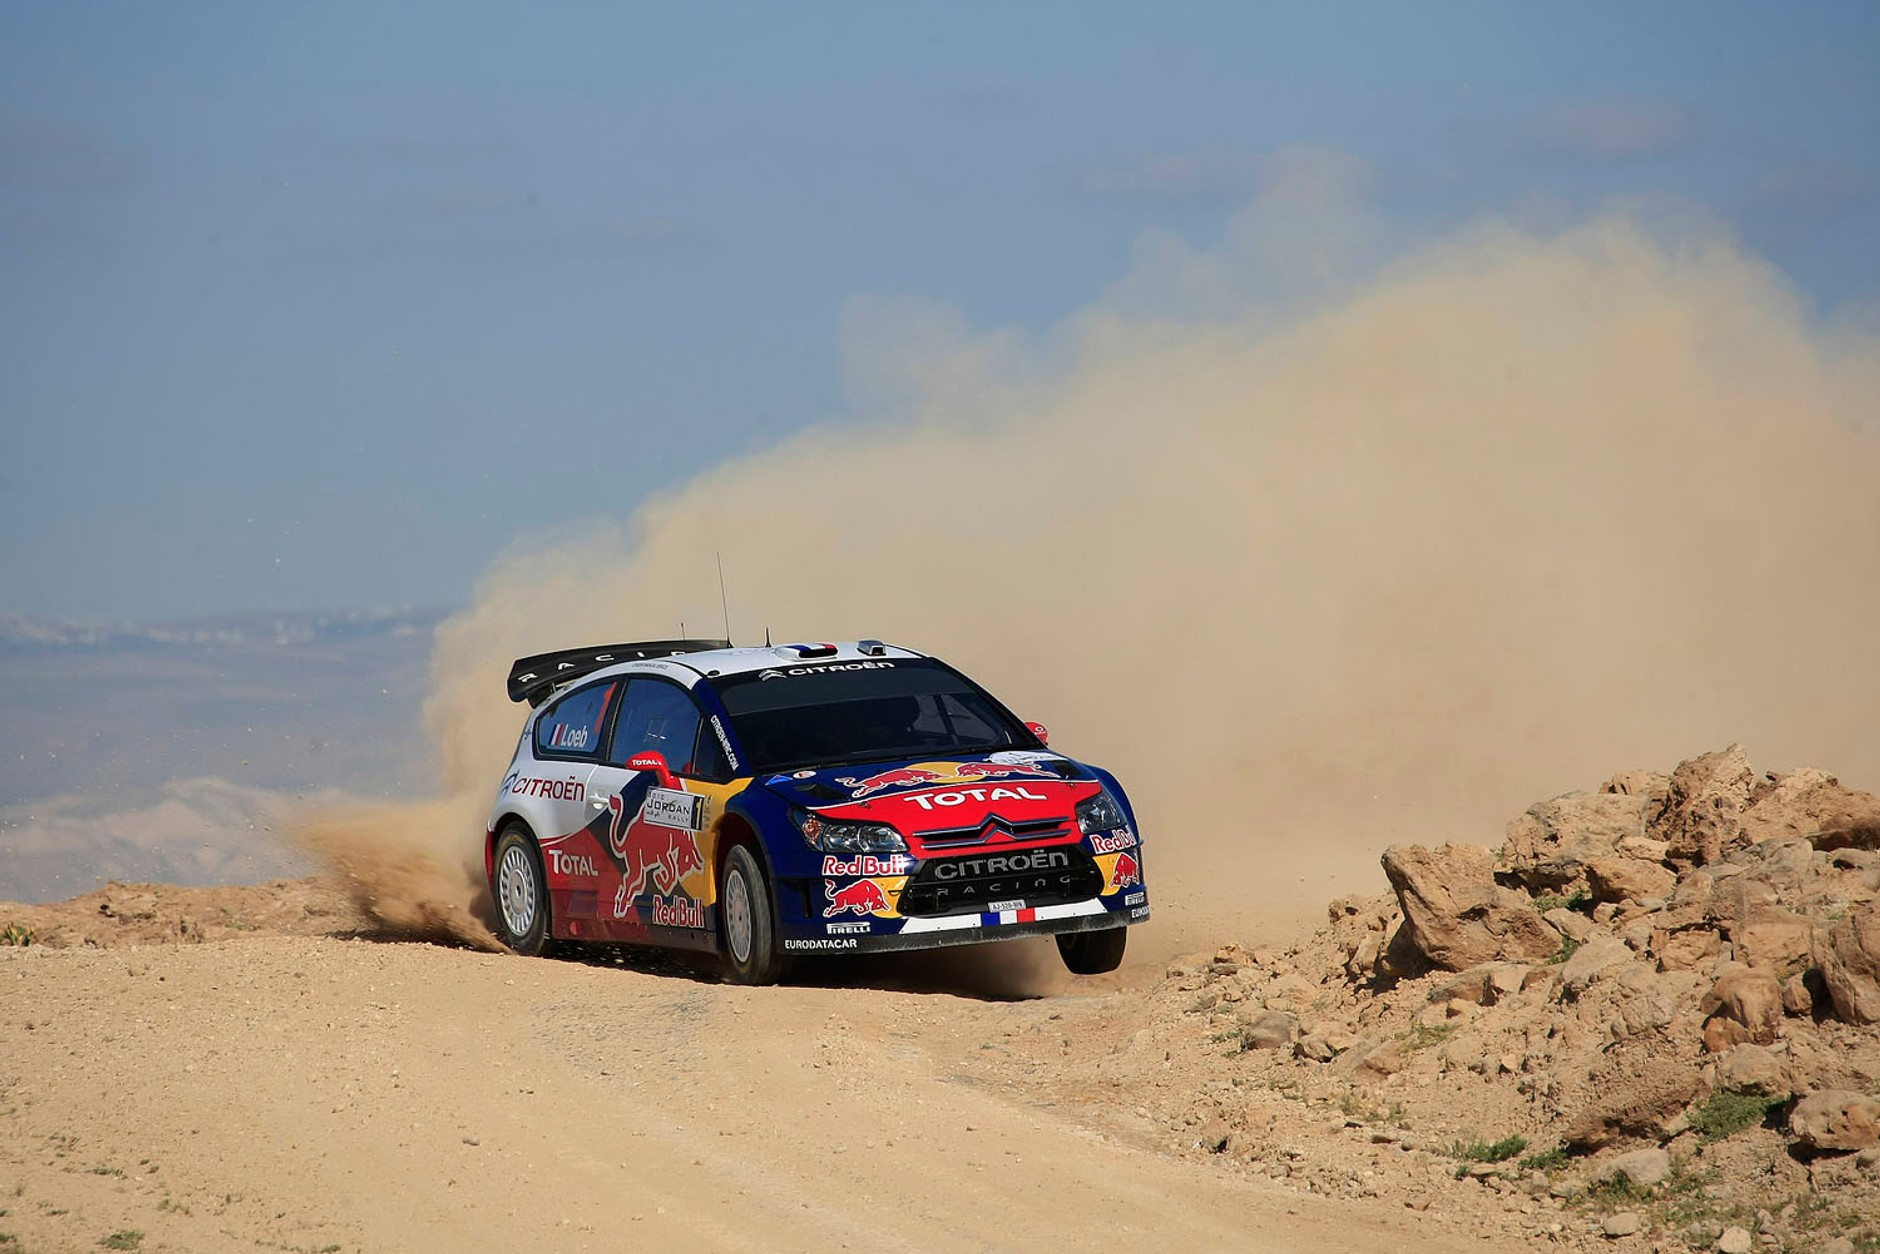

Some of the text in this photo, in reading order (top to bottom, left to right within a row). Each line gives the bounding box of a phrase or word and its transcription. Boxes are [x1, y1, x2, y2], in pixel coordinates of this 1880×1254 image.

[561, 723, 588, 748] Loeb
[511, 776, 585, 801] CITROËN
[903, 786, 1047, 811] TOTAL
[646, 799, 690, 815] JORDAN
[696, 798, 703, 829] 1
[1089, 829, 1122, 854] Red
[548, 849, 599, 876] TOTAL
[822, 855, 906, 876] Red Bull
[934, 849, 1069, 880] CITROËN
[937, 875, 1071, 897] RACING
[652, 895, 704, 927] Red Bull
[826, 921, 871, 935] PIRELLI
[784, 939, 858, 950] EURODATACAR
